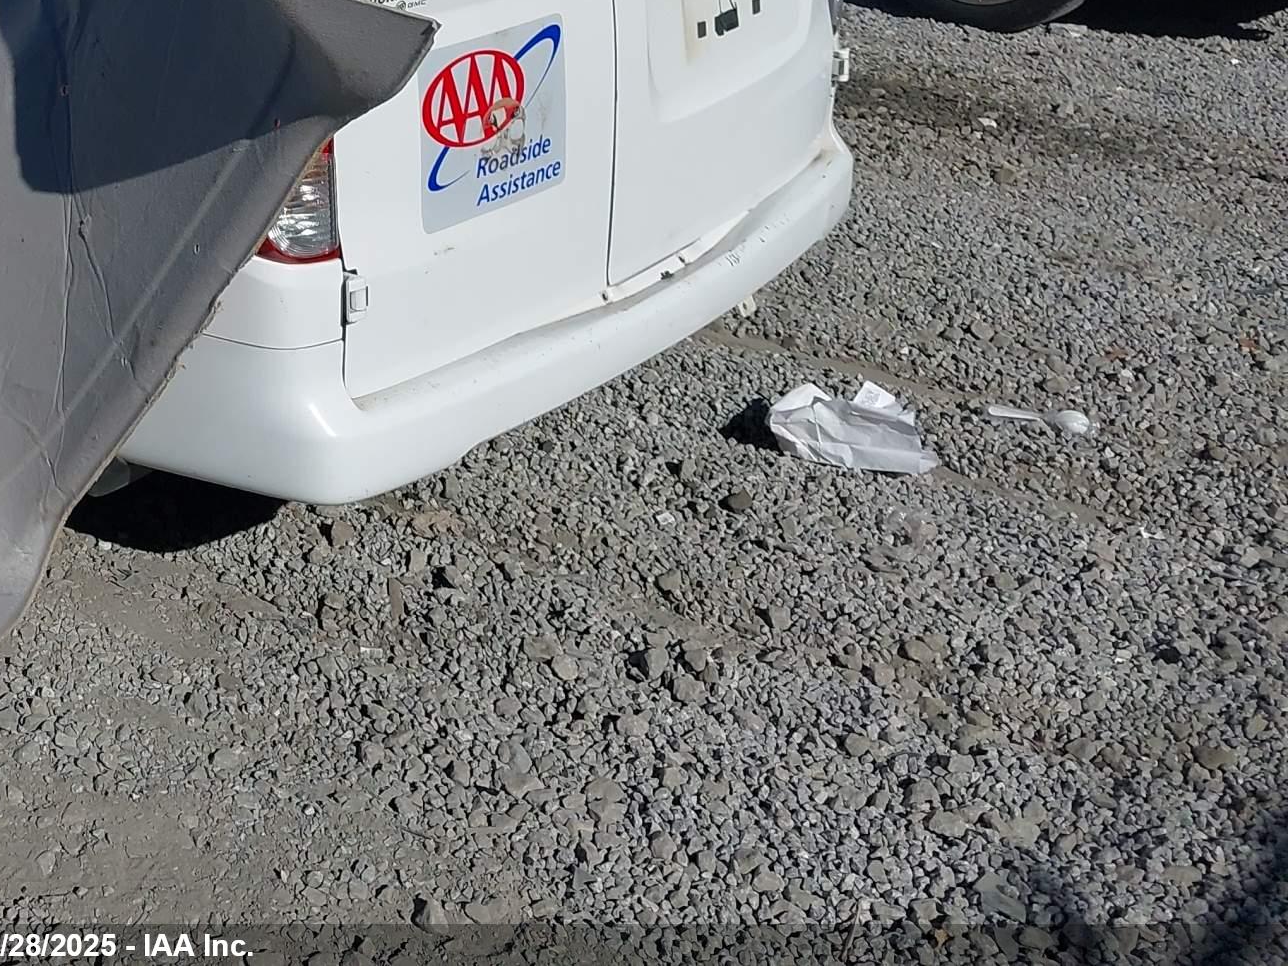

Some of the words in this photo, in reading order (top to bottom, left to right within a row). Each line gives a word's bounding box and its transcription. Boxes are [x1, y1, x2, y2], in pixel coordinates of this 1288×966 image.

[428, 52, 522, 145] AAA
[476, 134, 551, 179] Roadside
[477, 160, 561, 206] Assistance
